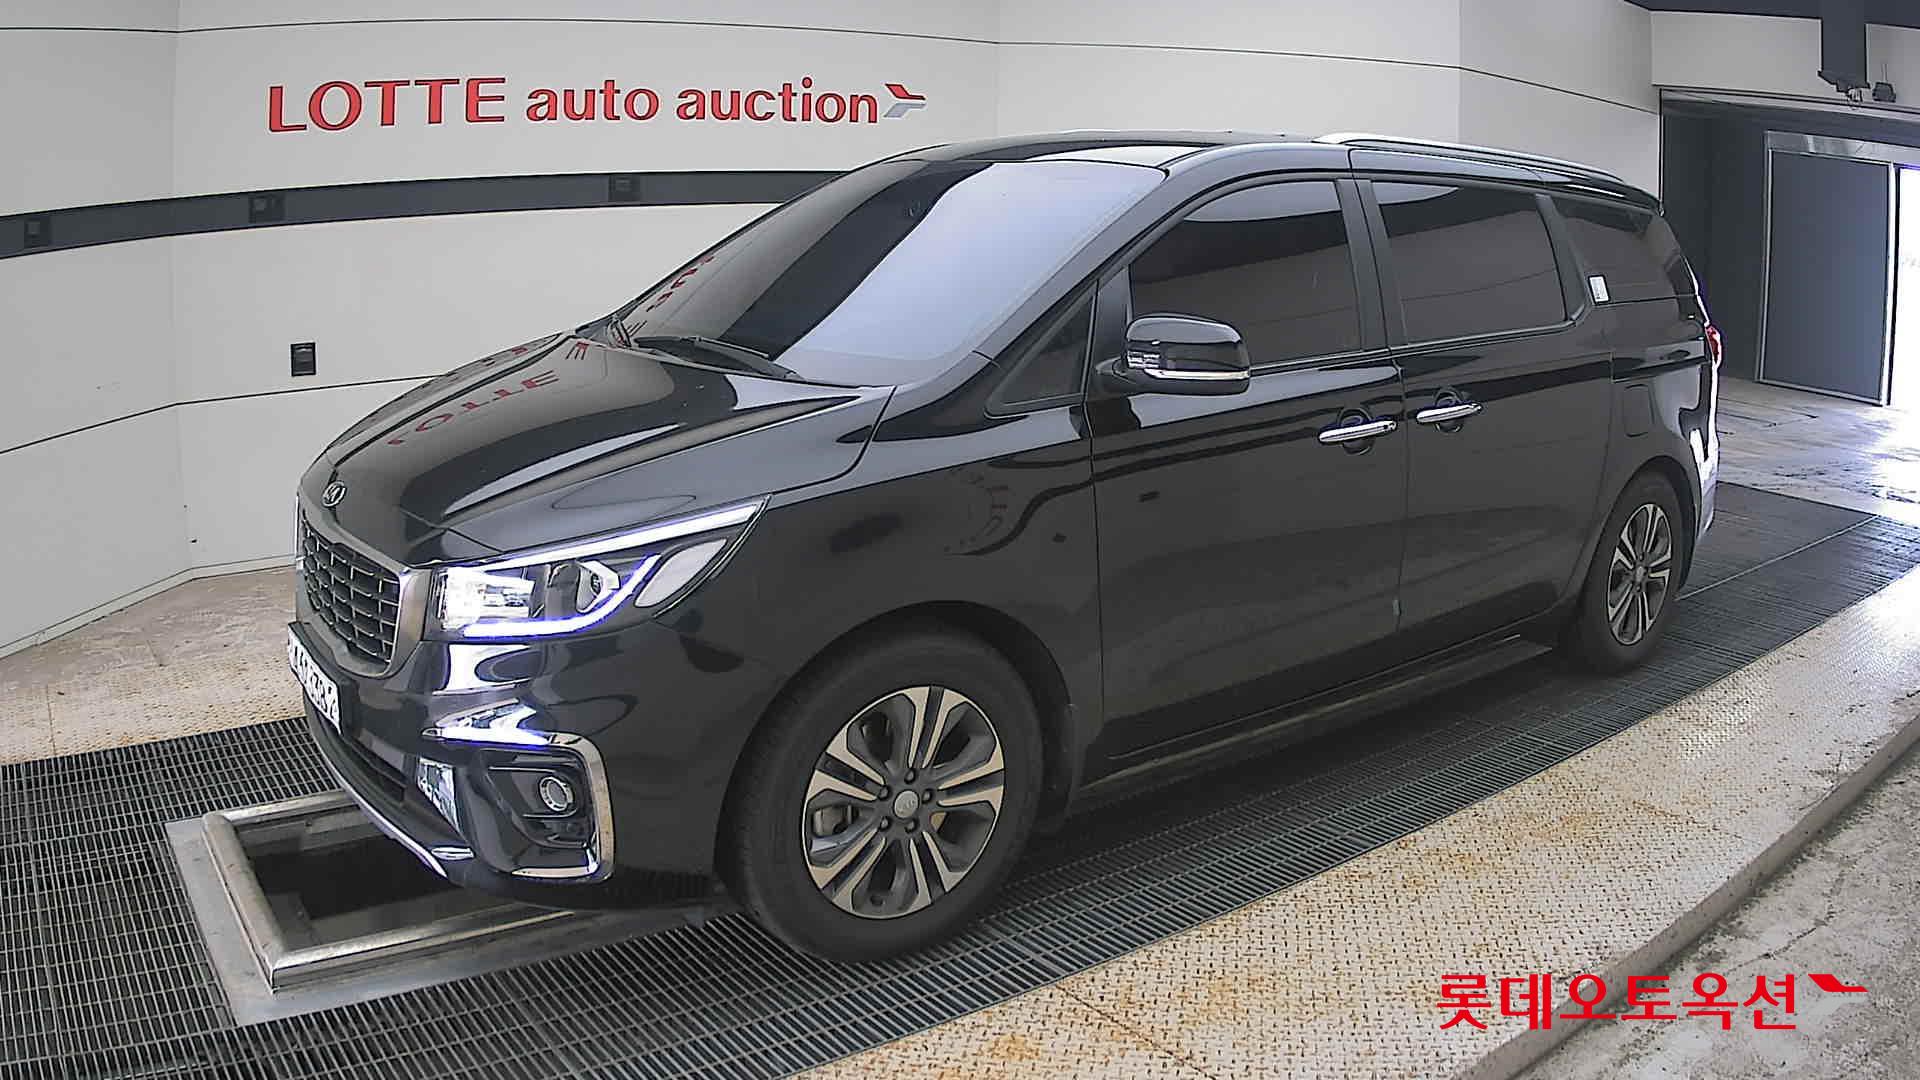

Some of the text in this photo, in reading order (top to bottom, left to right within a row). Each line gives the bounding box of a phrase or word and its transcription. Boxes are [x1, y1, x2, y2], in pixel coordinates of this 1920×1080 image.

[269, 77, 879, 133] LOTTE auto auction
